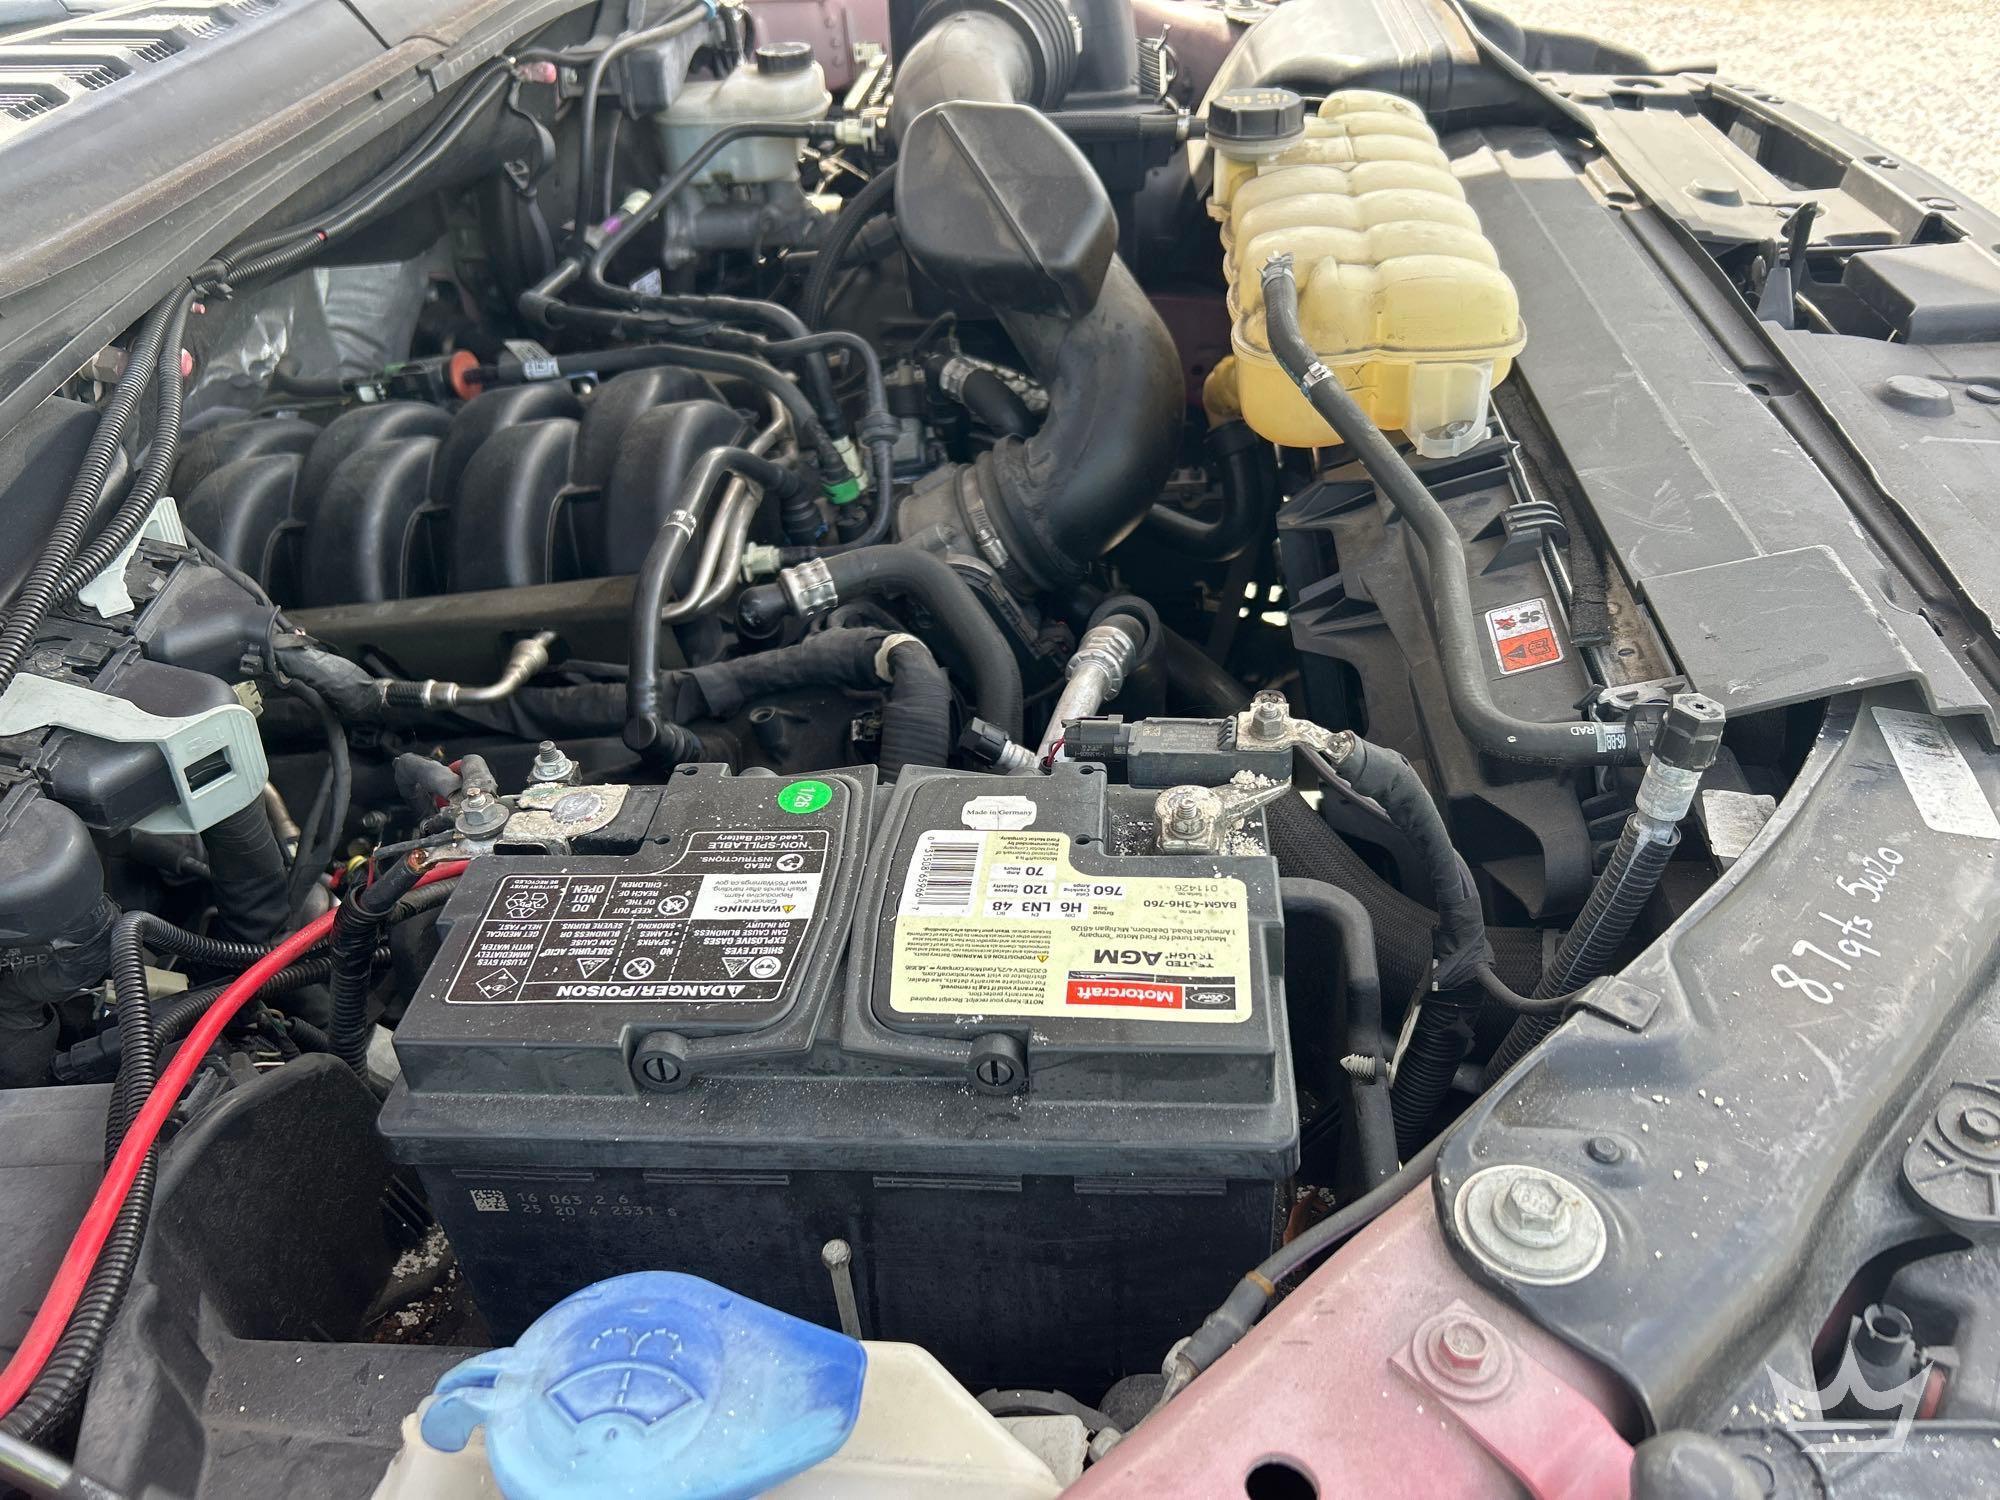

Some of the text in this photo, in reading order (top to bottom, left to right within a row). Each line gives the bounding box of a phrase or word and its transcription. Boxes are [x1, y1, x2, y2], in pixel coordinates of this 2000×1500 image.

[1570, 726, 1595, 736] RAD
[794, 786, 816, 806] 1/26
[708, 841, 808, 849] NON-SPILLABLE
[921, 849, 933, 870] 31508
[1026, 867, 1044, 876] 70
[571, 884, 605, 893] OPEN.
[915, 874, 927, 898] 65966
[1023, 885, 1048, 894] 120
[1094, 886, 1122, 896] 760
[572, 895, 597, 903] NOT
[571, 904, 590, 912] DO
[992, 901, 1082, 912] H6 LN3 48
[703, 937, 734, 945] GASES
[1094, 950, 1162, 966] AGM
[1770, 940, 1852, 1004] 8.7
[556, 985, 726, 996] DANGER/POISON
[1077, 986, 1174, 1003] Motorcraft
[550, 1194, 583, 1205] 063
[595, 1195, 605, 1204] 2
[618, 1195, 628, 1204] 6
[522, 1204, 542, 1214] 25
